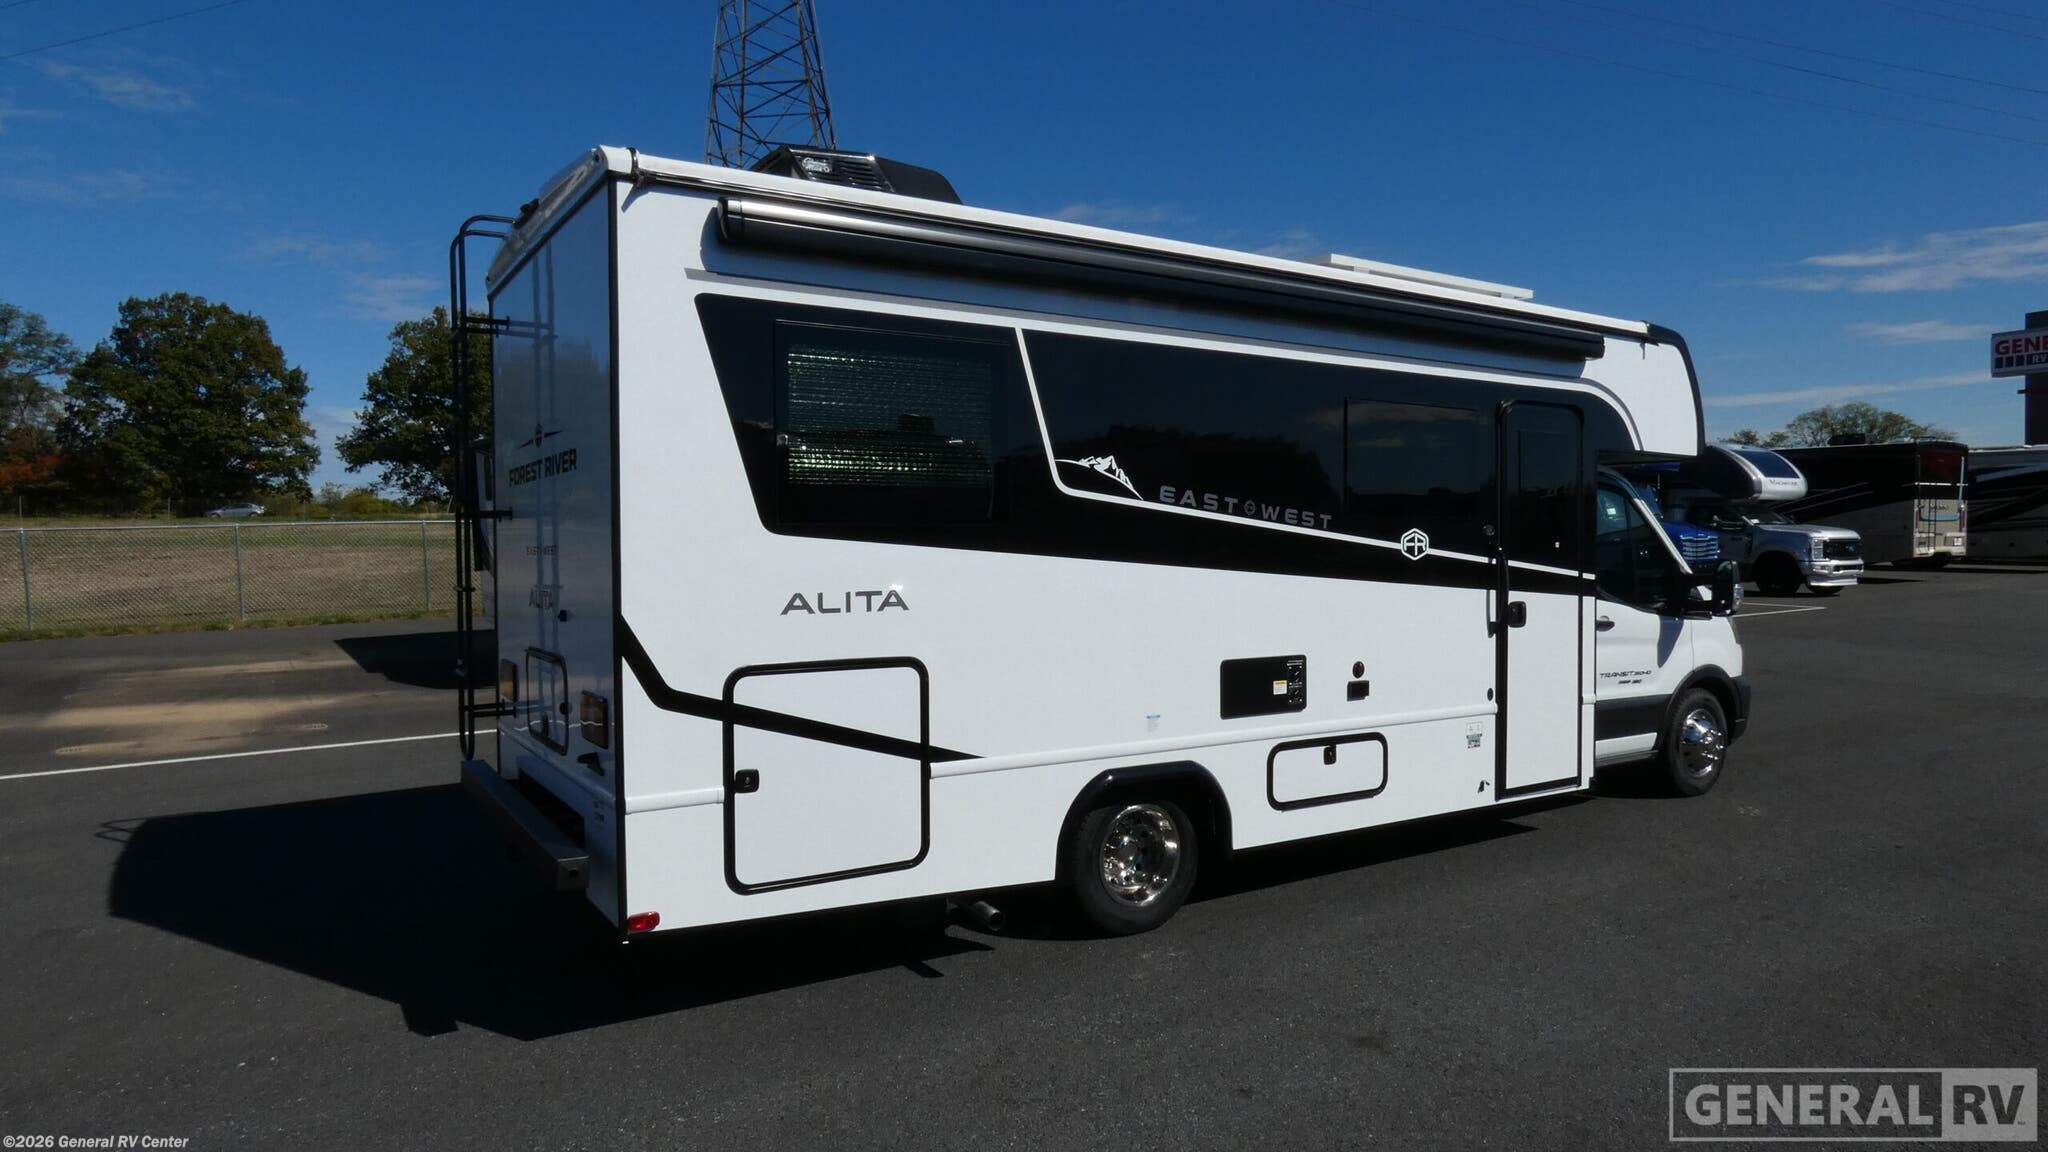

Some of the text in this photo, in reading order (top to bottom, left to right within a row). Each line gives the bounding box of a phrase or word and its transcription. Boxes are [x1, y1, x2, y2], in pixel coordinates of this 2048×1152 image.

[509, 448, 577, 488] FOREST RIVER
[1159, 485, 1333, 530] EAST WEST
[780, 589, 909, 615] ALITA
[1600, 670, 1634, 679] TRANSIT
